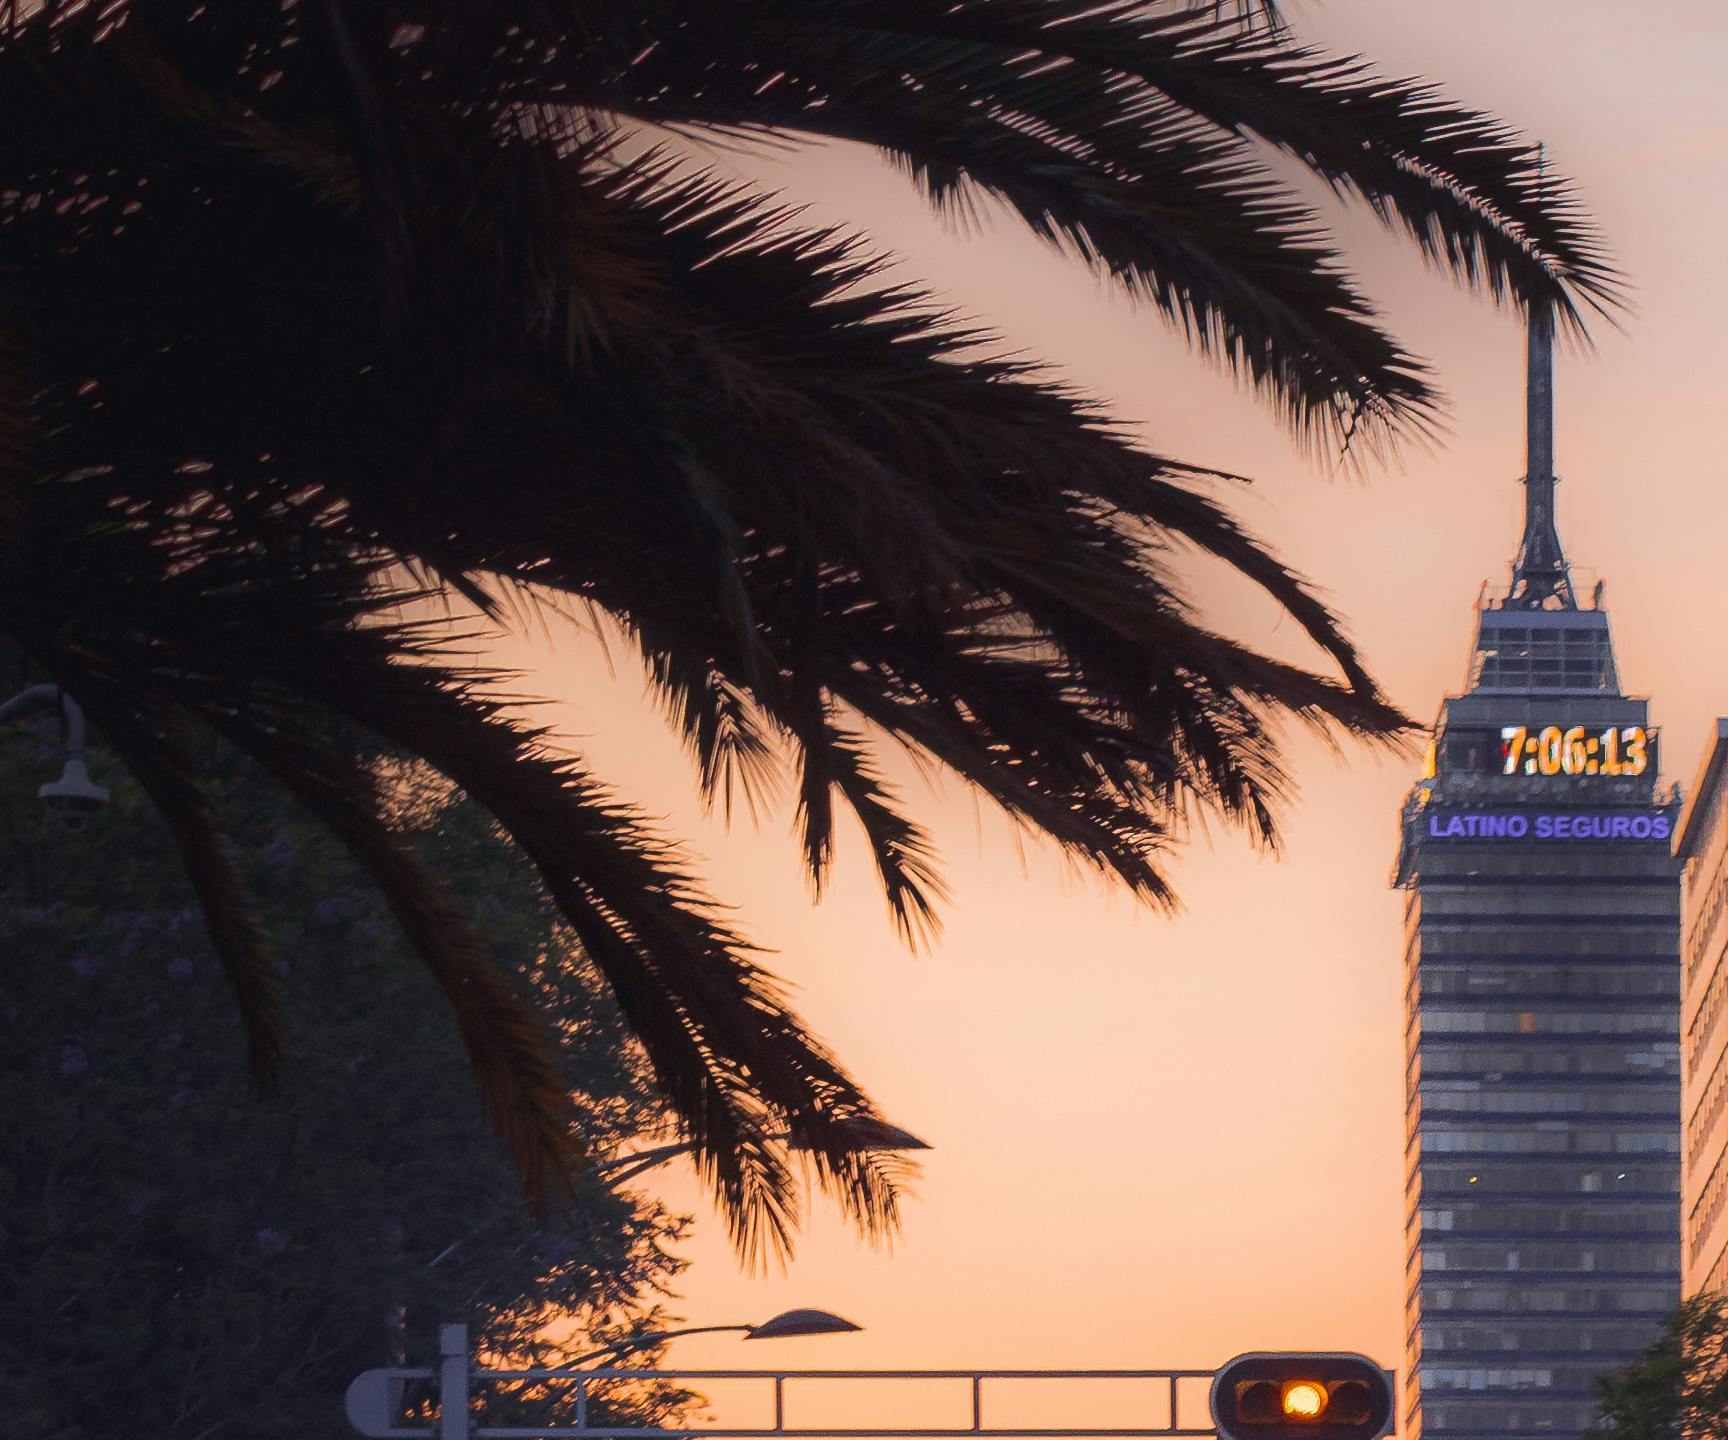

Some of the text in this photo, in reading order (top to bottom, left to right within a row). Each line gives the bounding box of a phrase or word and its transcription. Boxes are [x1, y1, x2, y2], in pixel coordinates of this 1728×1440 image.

[1500, 725, 1648, 776] 7:06:13
[1429, 815, 1670, 839] LATINO SEGUROS
